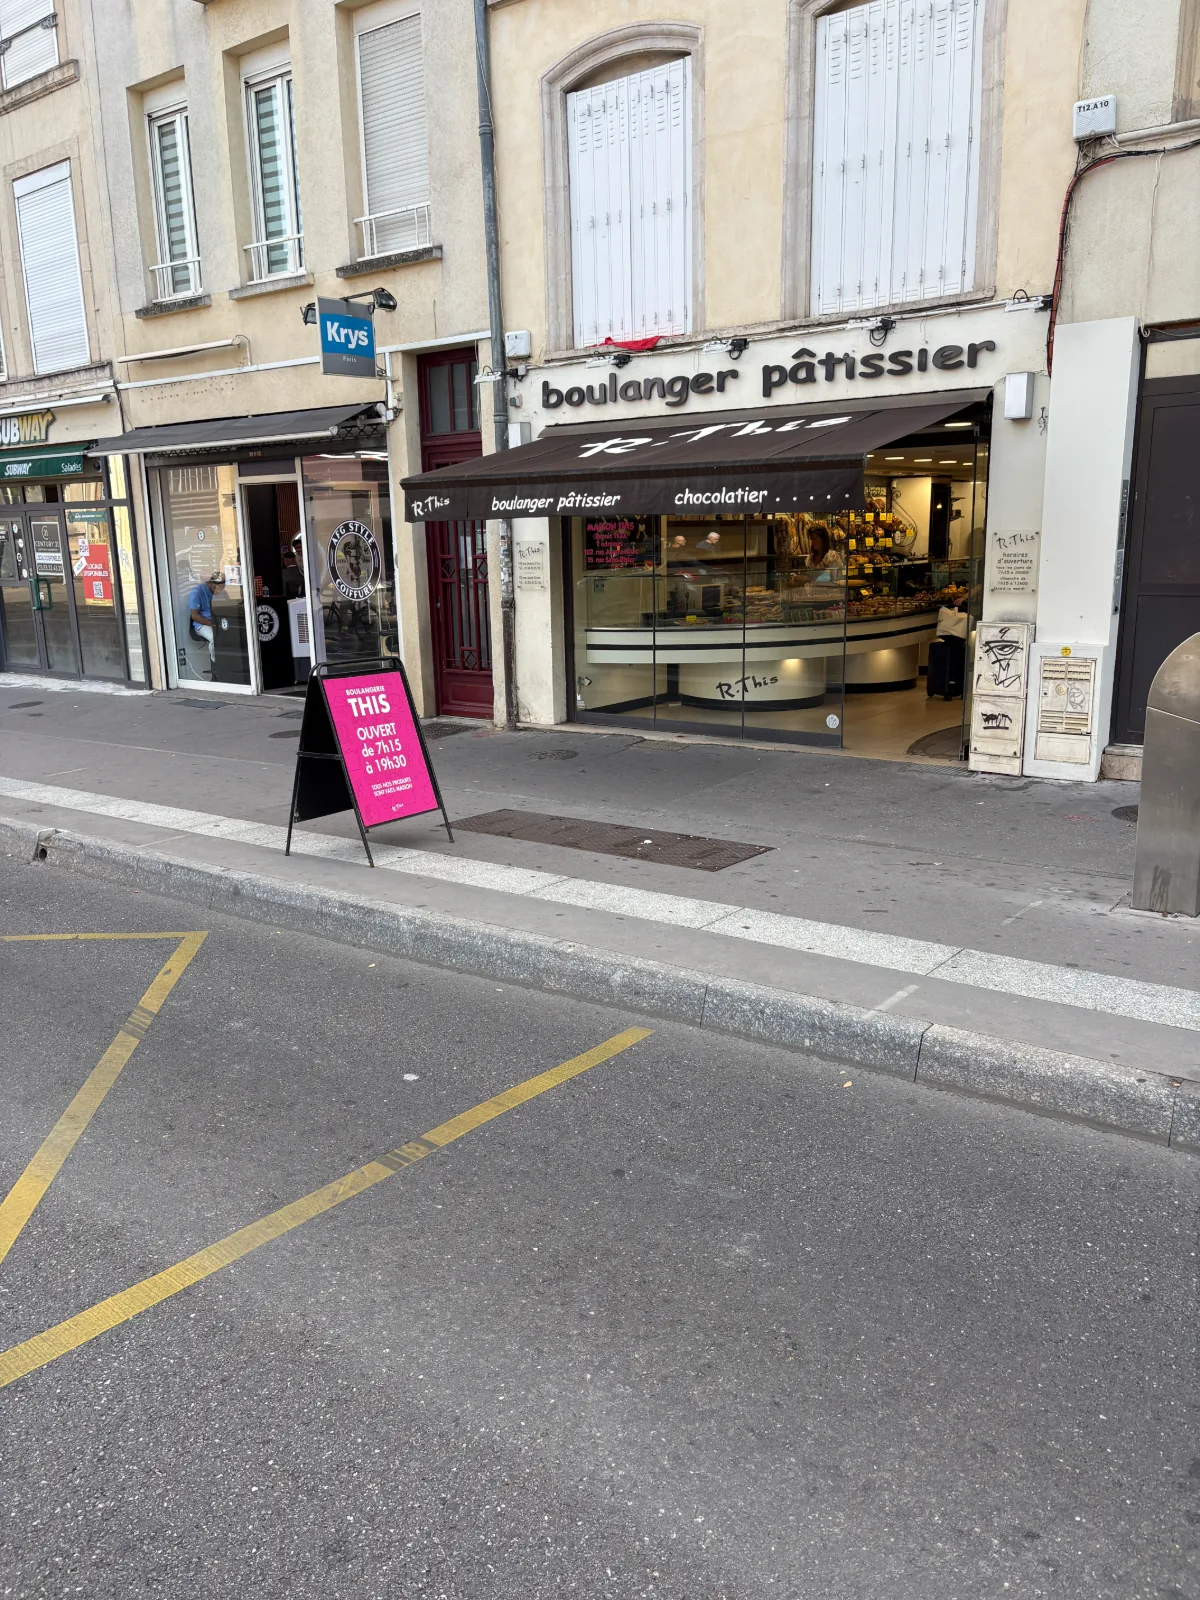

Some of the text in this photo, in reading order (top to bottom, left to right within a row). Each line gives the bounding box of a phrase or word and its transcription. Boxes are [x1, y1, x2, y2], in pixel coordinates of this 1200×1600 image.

[326, 320, 369, 349] Krys
[541, 339, 996, 409] boulanger pâtissier
[0, 409, 53, 444] UBWAY
[4, 462, 33, 476] SUBWAY
[61, 461, 82, 473] Salades
[491, 491, 621, 513] boulanger pâtissier
[674, 487, 768, 506] chocolatier
[348, 522, 375, 546] STYLE
[335, 578, 374, 599] COIFFURE
[345, 685, 386, 696] BOULANGERIE
[347, 694, 391, 718] THIS
[356, 722, 397, 741] OUVERT
[361, 738, 402, 758] de 7h15
[365, 754, 407, 775] à 19h30
